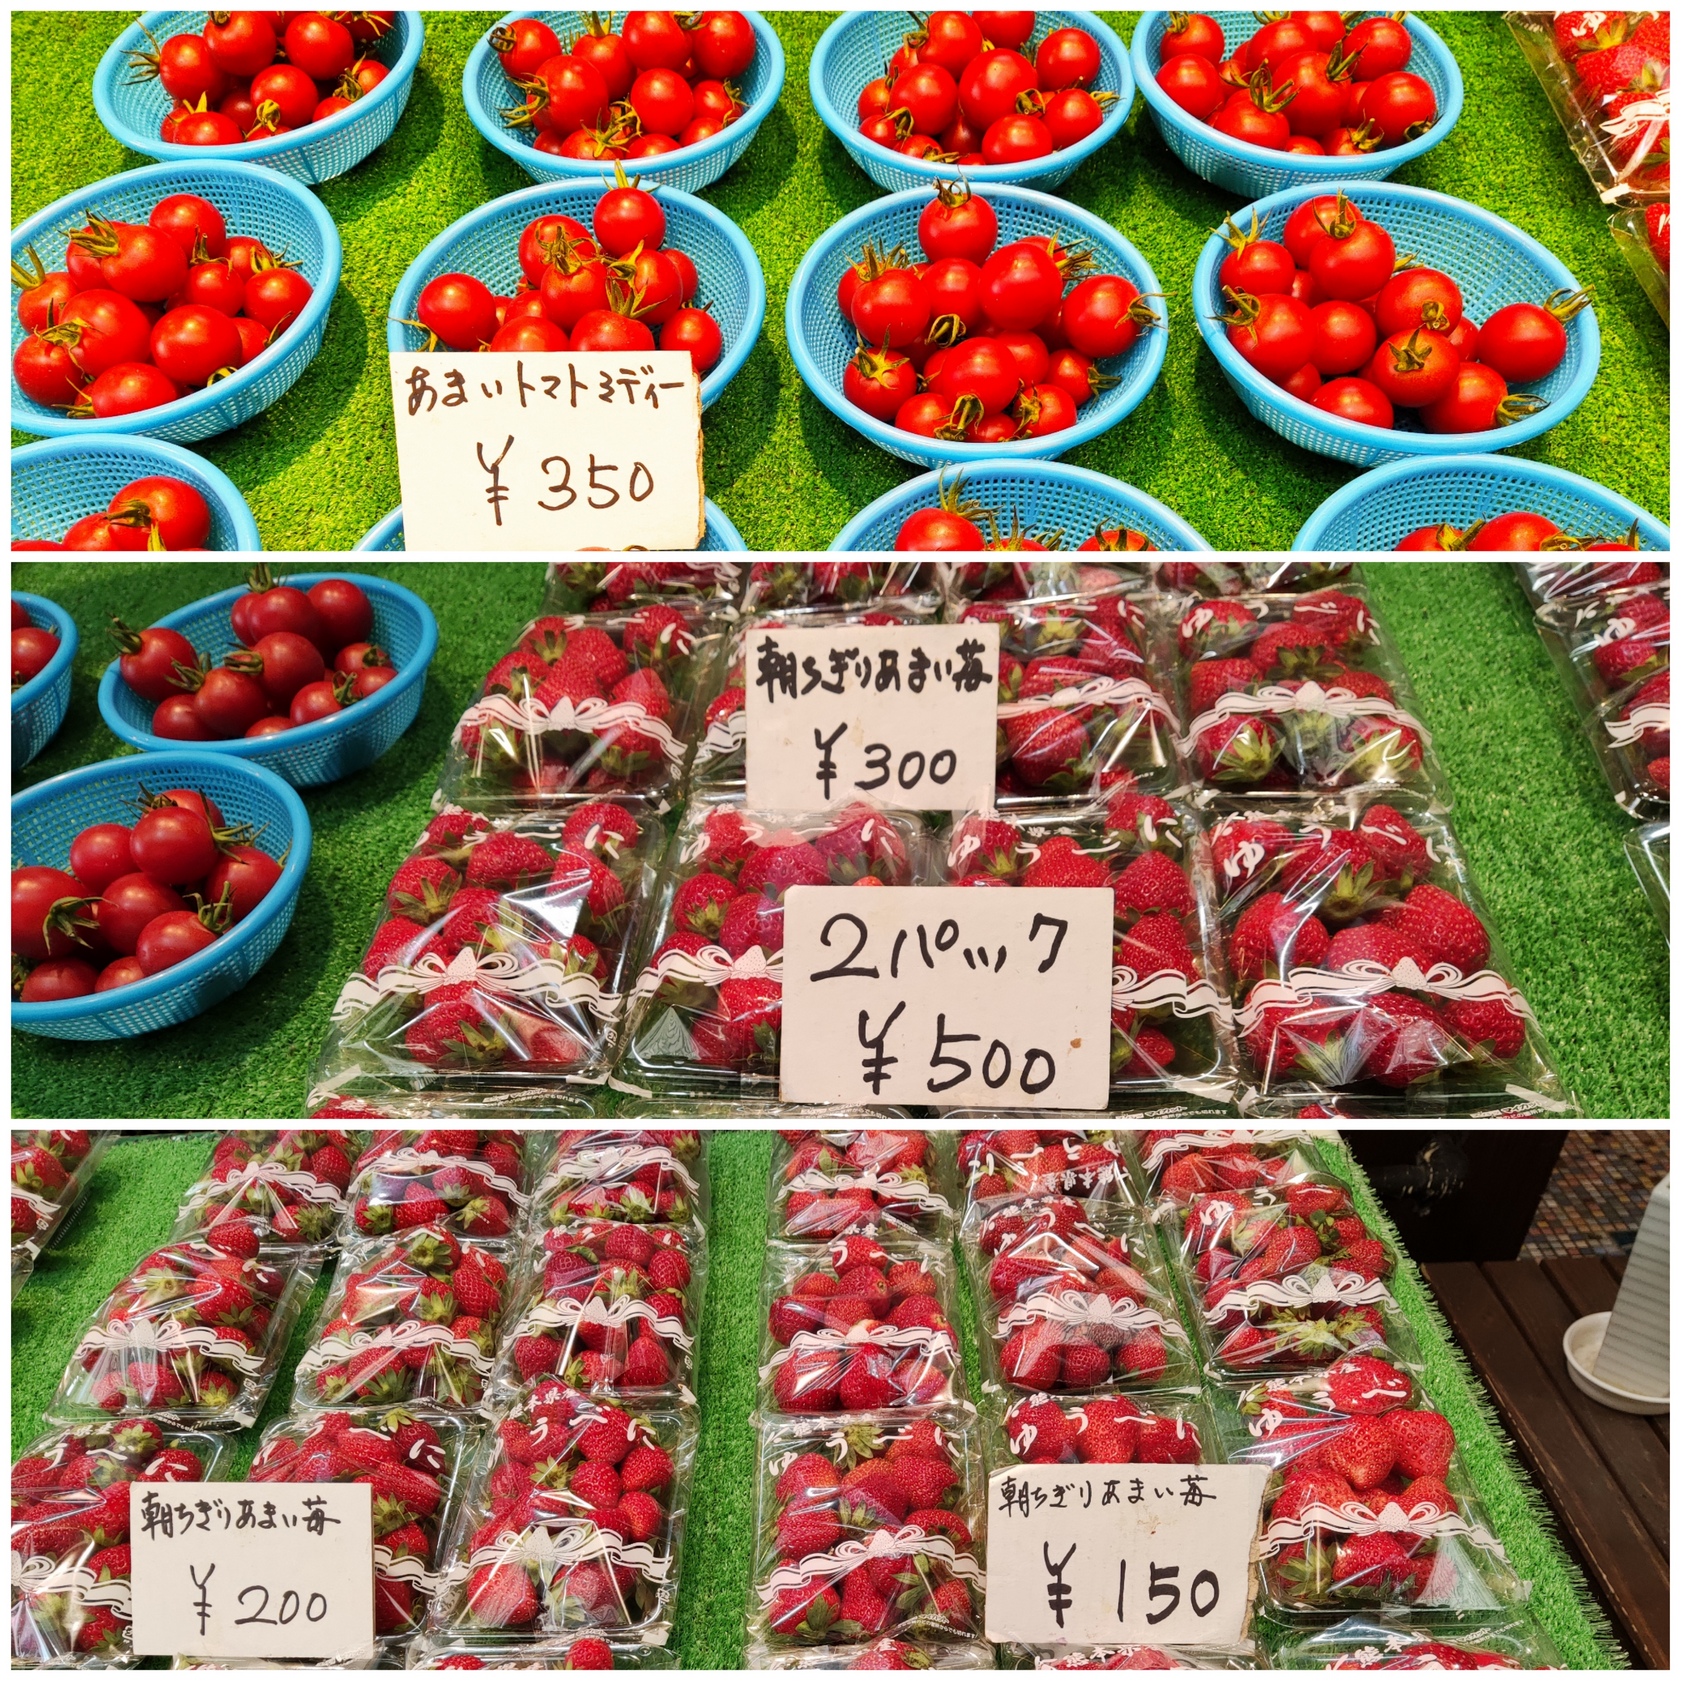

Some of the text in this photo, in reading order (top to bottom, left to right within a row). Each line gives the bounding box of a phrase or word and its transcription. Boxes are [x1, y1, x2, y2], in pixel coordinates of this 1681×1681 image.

[404, 359, 685, 417] あまいトマトミディー
[756, 635, 993, 703] 朝ちぎりあまい苺
[810, 912, 1068, 982] 2パック
[140, 1490, 341, 1541] 朝ちぎりあまい苺
[998, 1474, 1217, 1518] 朝ちぎりあまい苺
